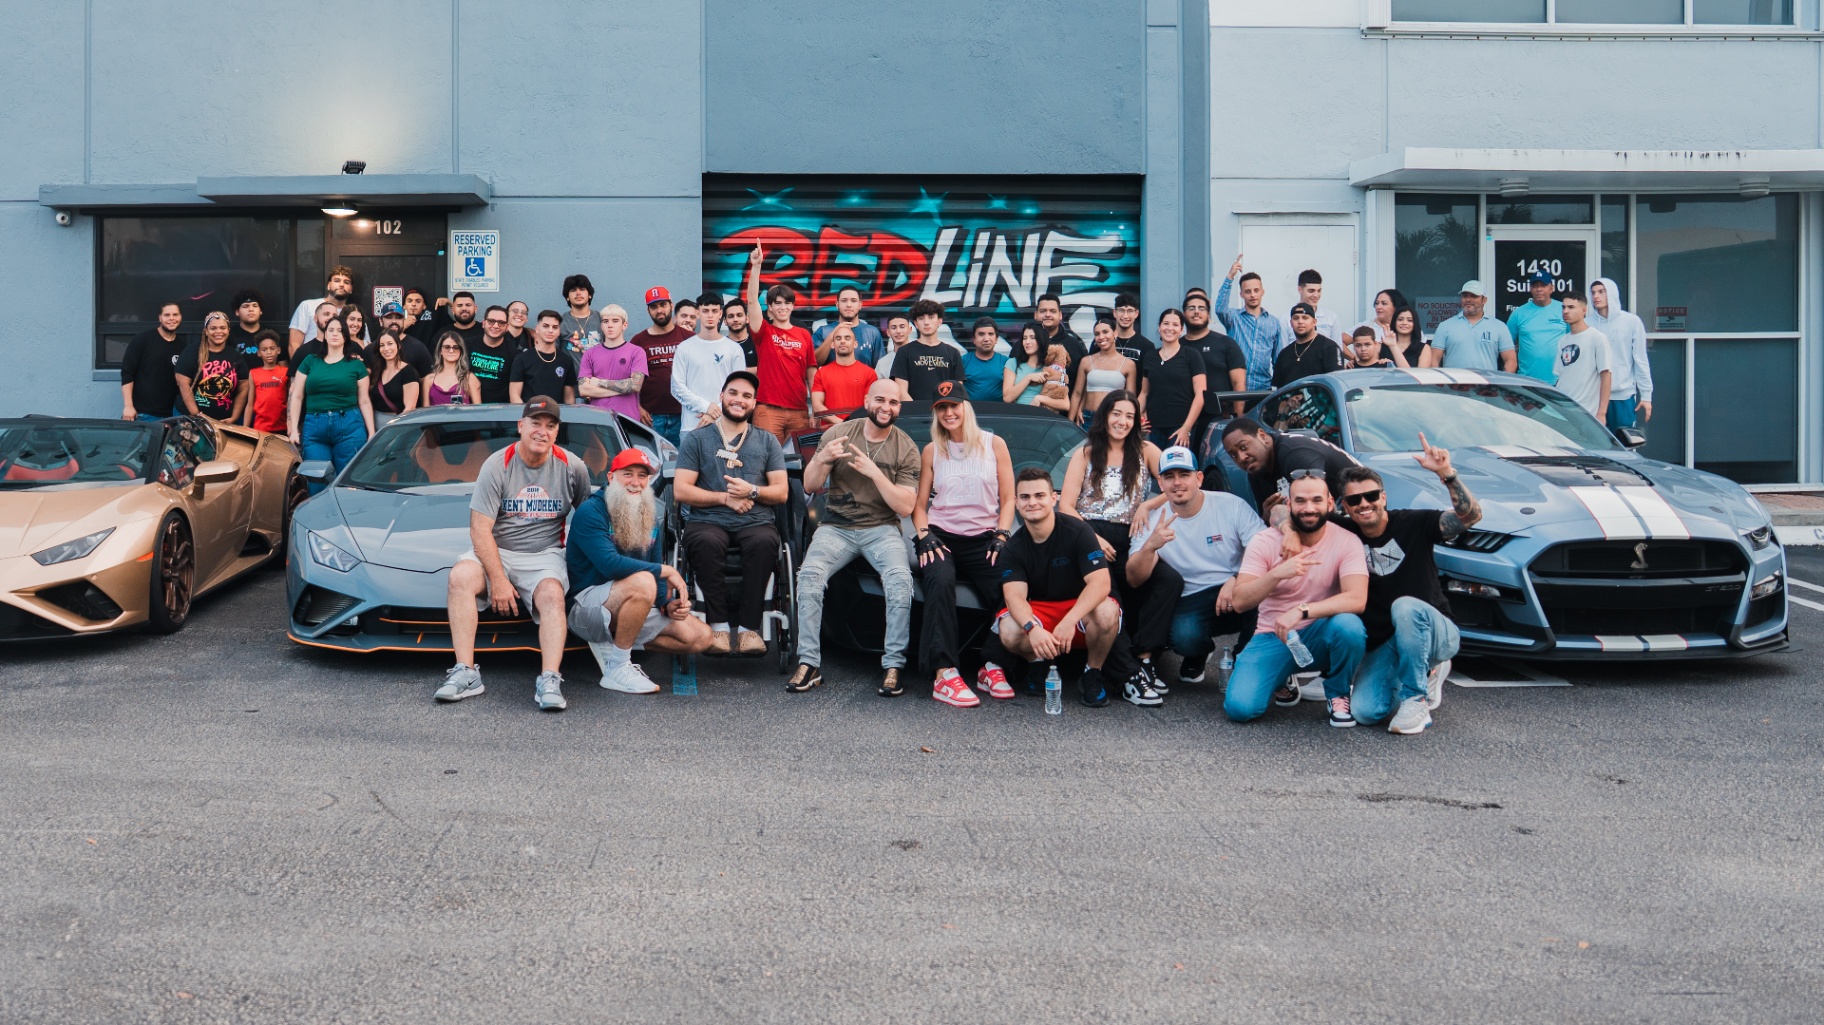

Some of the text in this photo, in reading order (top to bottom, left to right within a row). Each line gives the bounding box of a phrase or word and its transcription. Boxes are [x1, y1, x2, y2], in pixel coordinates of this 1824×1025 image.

[375, 220, 402, 235] 102
[454, 234, 496, 245] RESERVED
[457, 245, 493, 256] PARKING
[1516, 259, 1562, 276] 1430
[1507, 279, 1531, 292] Sui
[649, 345, 677, 356] TRUM
[502, 499, 562, 511] KENT MUDHENS
